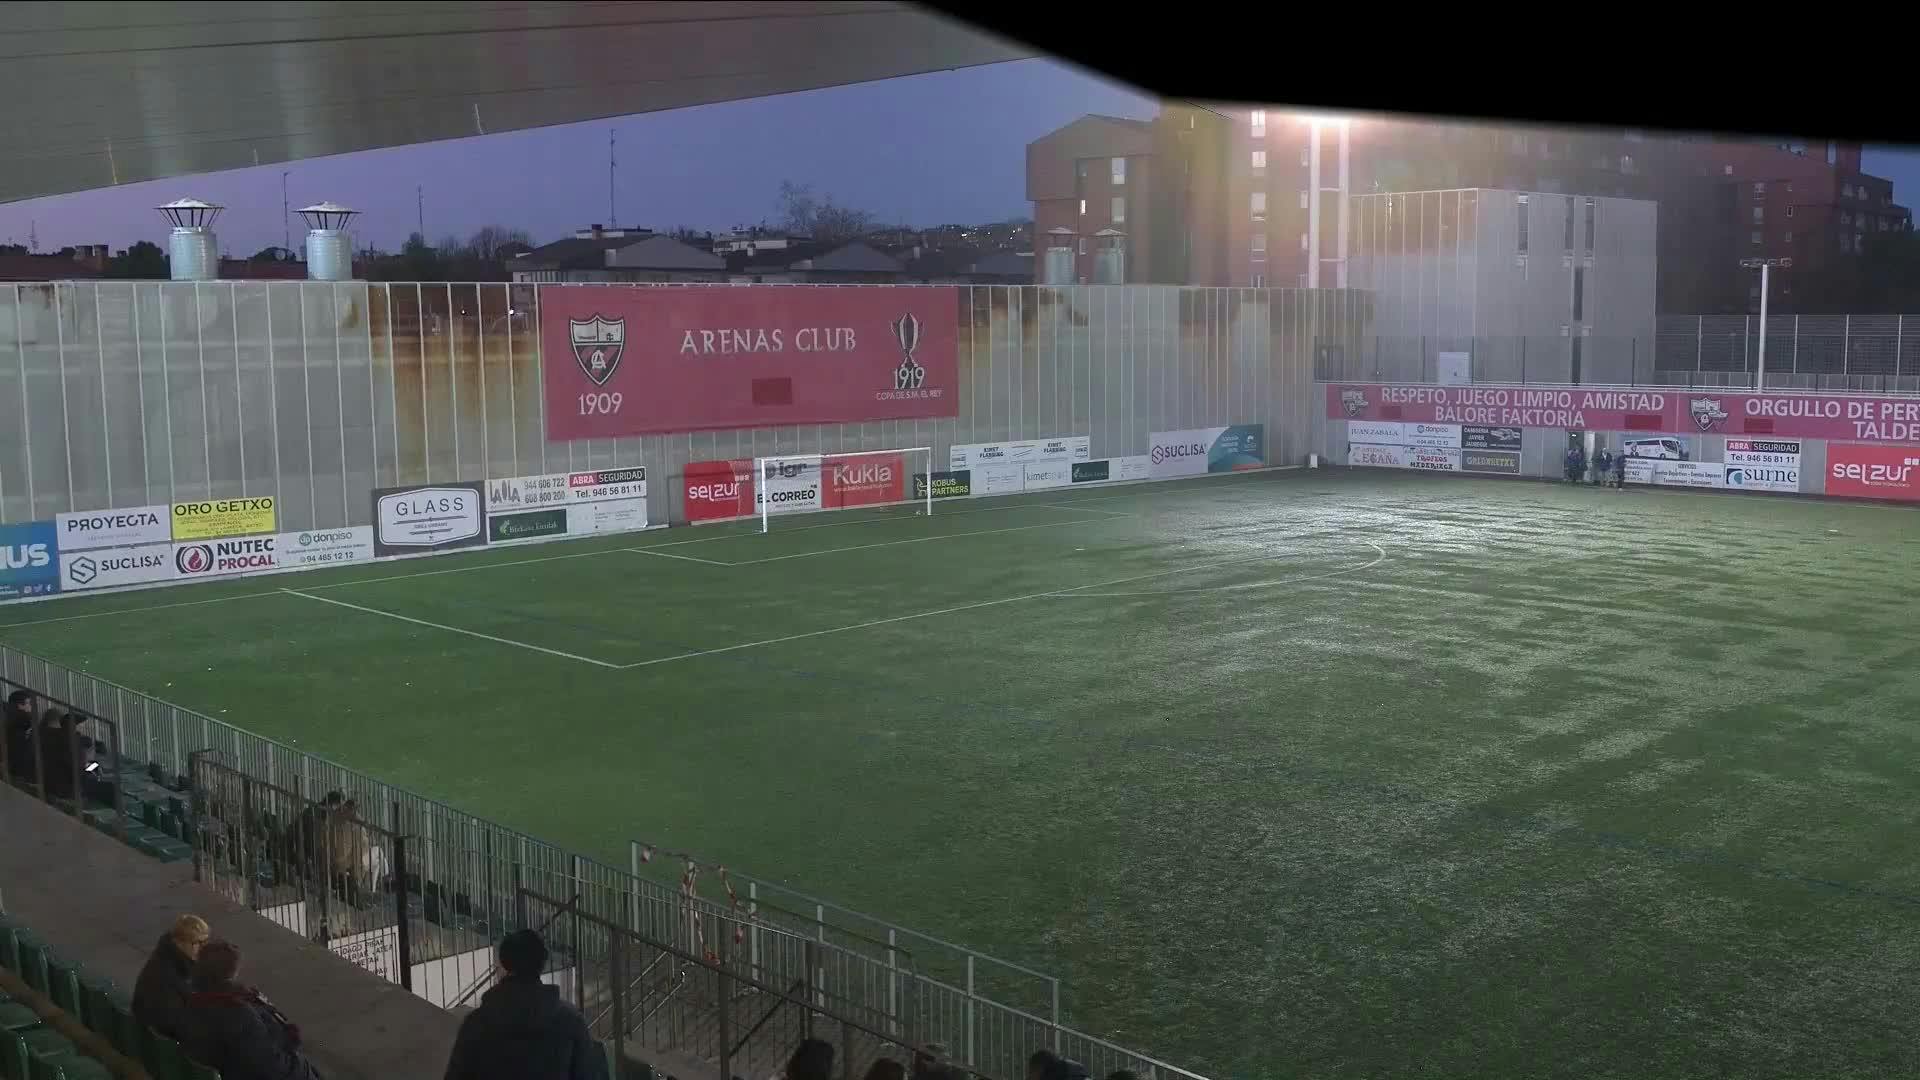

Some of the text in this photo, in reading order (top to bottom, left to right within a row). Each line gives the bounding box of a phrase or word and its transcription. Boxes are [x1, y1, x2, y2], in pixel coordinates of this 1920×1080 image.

[680, 327, 857, 353] ARENAS CLUB
[894, 367, 925, 390] 1919
[578, 392, 622, 415] 1909
[1381, 387, 1664, 411] RESPETO, JUEGO LIMPIO, AMISTAD
[1435, 406, 1585, 427] BALORE FAKTORIA
[1745, 399, 1841, 418] ORGULLO
[1848, 401, 1875, 420] DE
[1729, 442, 1797, 452] ABRA SEGURIDAD
[1731, 453, 1745, 461] Tel.
[553, 477, 565, 487] 722
[573, 470, 643, 485] ABRA SEGURIDAD
[833, 463, 892, 485] Kukla
[1744, 468, 1797, 483] surne
[1833, 463, 1911, 485] selzur
[575, 489, 591, 499] Tel.
[592, 488, 607, 497] 946
[621, 486, 631, 494] 81
[632, 484, 641, 493] 11
[771, 489, 815, 503] CORREO
[931, 485, 968, 496] PARTNERS
[174, 498, 273, 516] ORO GETXO
[396, 497, 464, 516] GLASS
[313, 532, 353, 543] donpiso
[217, 538, 274, 556] NUTEC
[101, 554, 163, 572] SUCLISA
[218, 554, 275, 570] PROCAL
